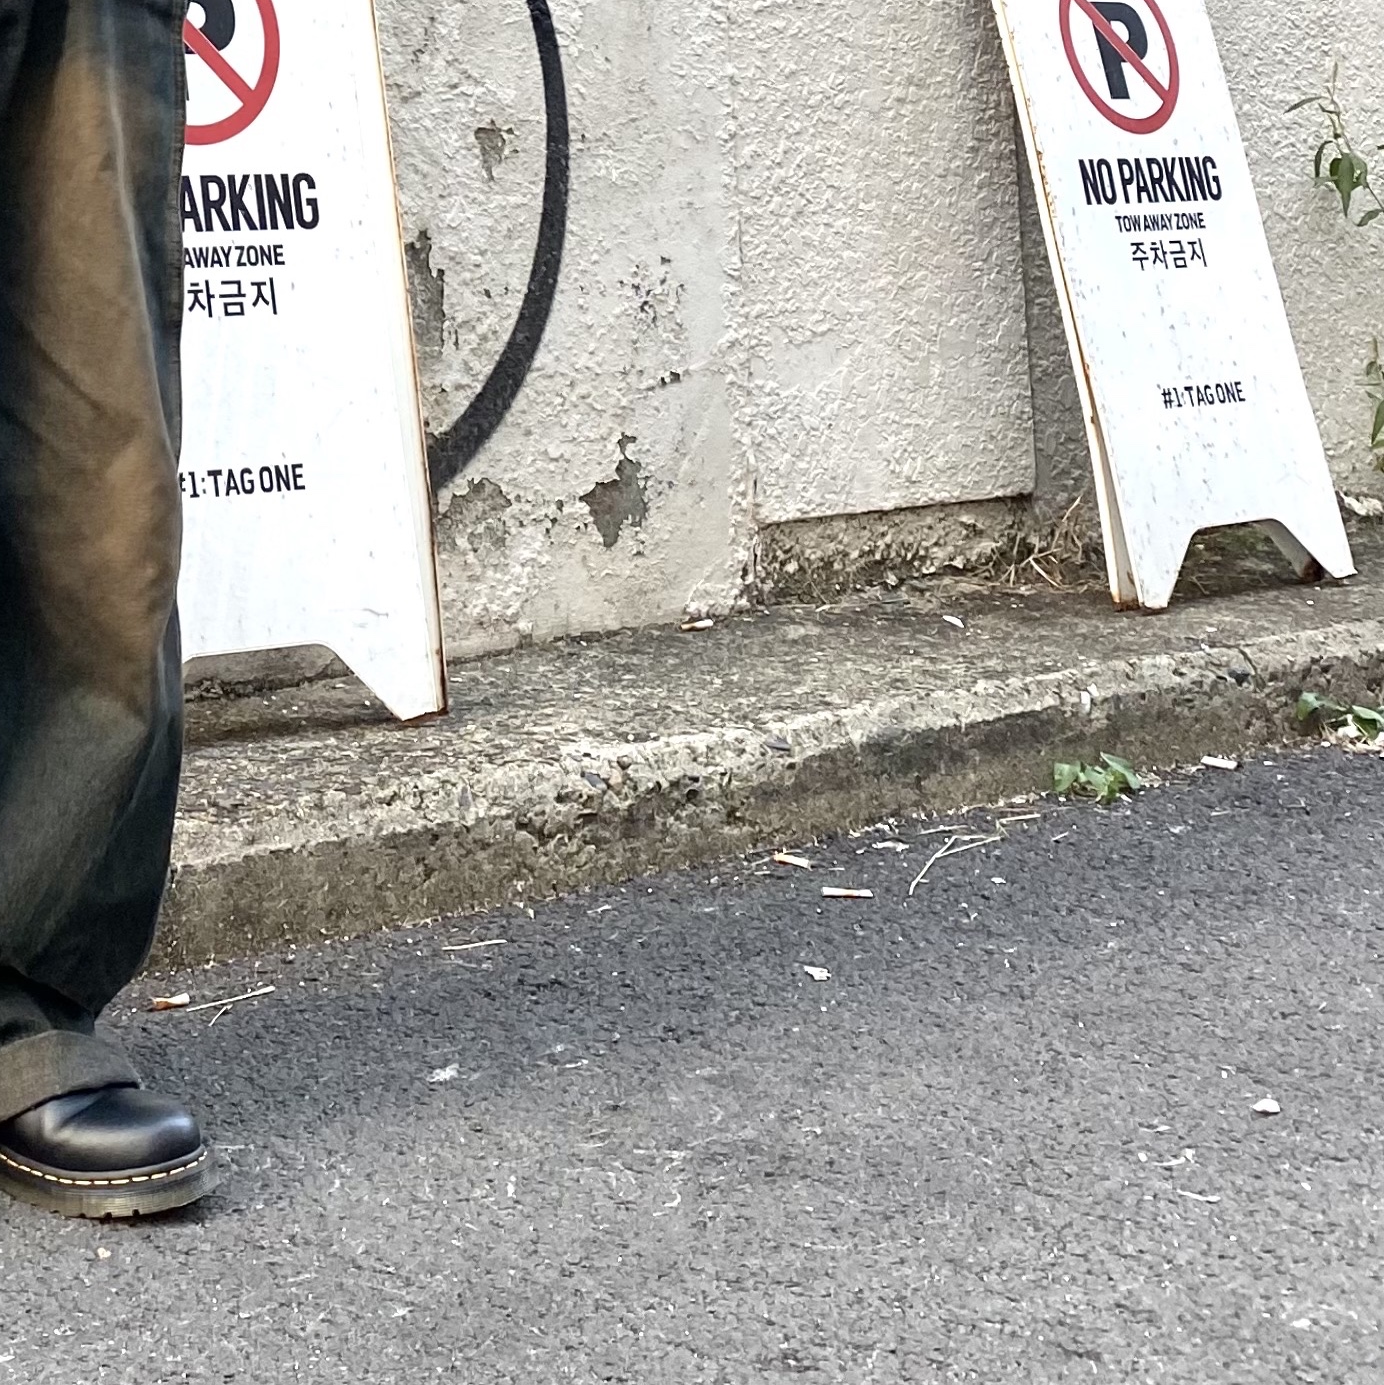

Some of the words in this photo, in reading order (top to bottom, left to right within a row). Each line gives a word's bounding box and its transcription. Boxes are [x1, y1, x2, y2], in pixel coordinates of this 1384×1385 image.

[1078, 158, 1117, 205] NO
[1117, 156, 1222, 204] PARKING
[180, 173, 320, 233] ARKING
[1115, 215, 1141, 233] TOW
[1143, 213, 1173, 232] AWAY
[1174, 212, 1206, 230] ZONE
[183, 246, 232, 269] AWAY
[234, 244, 285, 267] ZONE
[1130, 238, 1208, 271] 주차금지
[187, 277, 277, 318] 차금지
[1215, 381, 1246, 404] ONE
[258, 463, 306, 493] ONE
